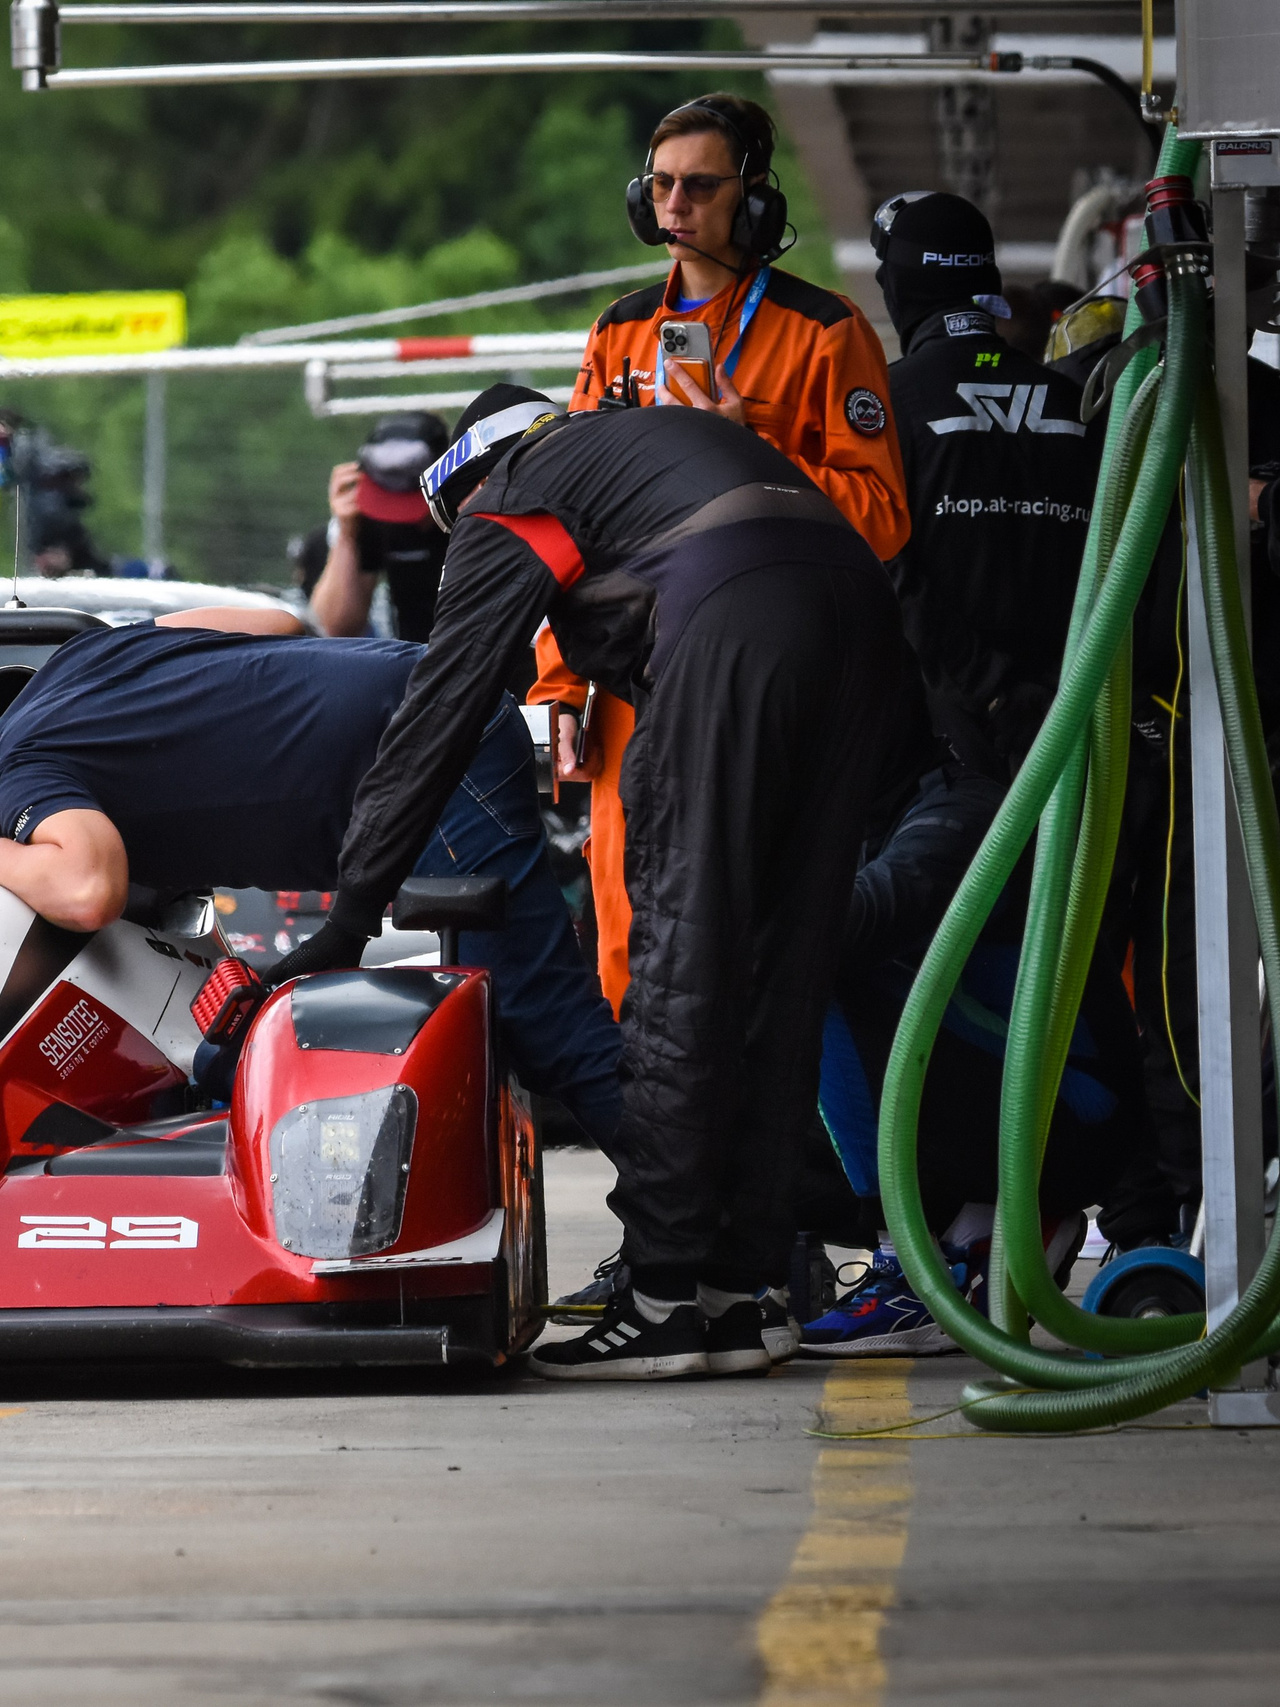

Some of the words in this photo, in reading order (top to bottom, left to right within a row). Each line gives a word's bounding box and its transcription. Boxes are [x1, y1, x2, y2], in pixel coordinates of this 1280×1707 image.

[935, 494, 1091, 523] shop.at-racing.ru
[38, 999, 100, 1067] SENSOTEC
[59, 1053, 85, 1081] sensing
[88, 1022, 111, 1049] control
[17, 1215, 200, 1249] 29
